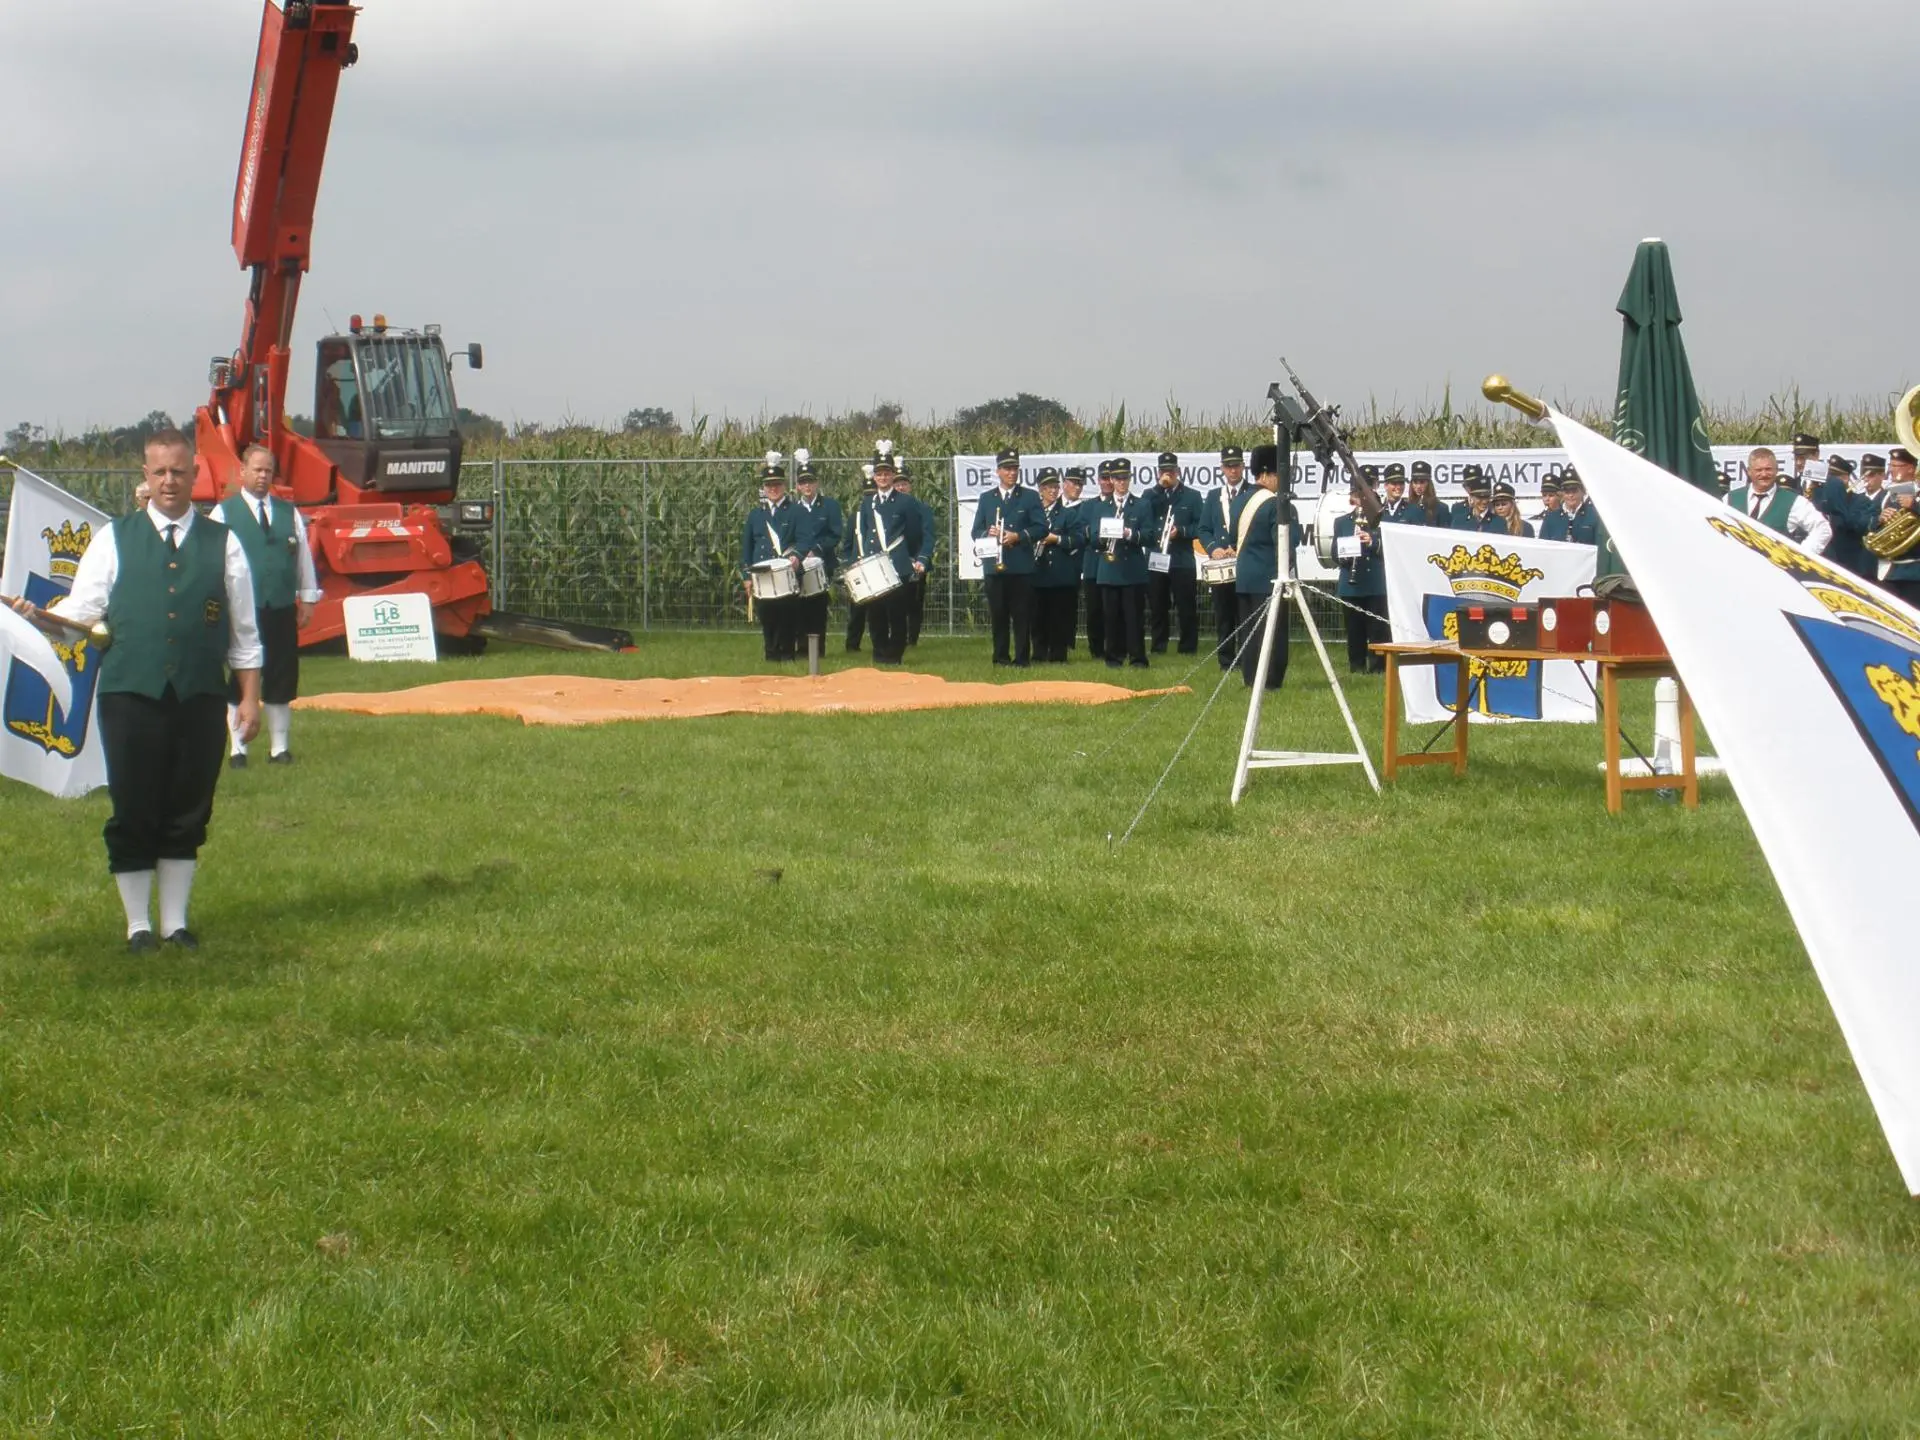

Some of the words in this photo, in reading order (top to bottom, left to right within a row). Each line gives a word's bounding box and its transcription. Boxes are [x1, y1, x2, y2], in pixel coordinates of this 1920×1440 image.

[386, 460, 446, 475] MANITOU
[966, 468, 992, 487] DE
[1178, 465, 1252, 486] WORT
[1434, 463, 1542, 484] GEAAKT
